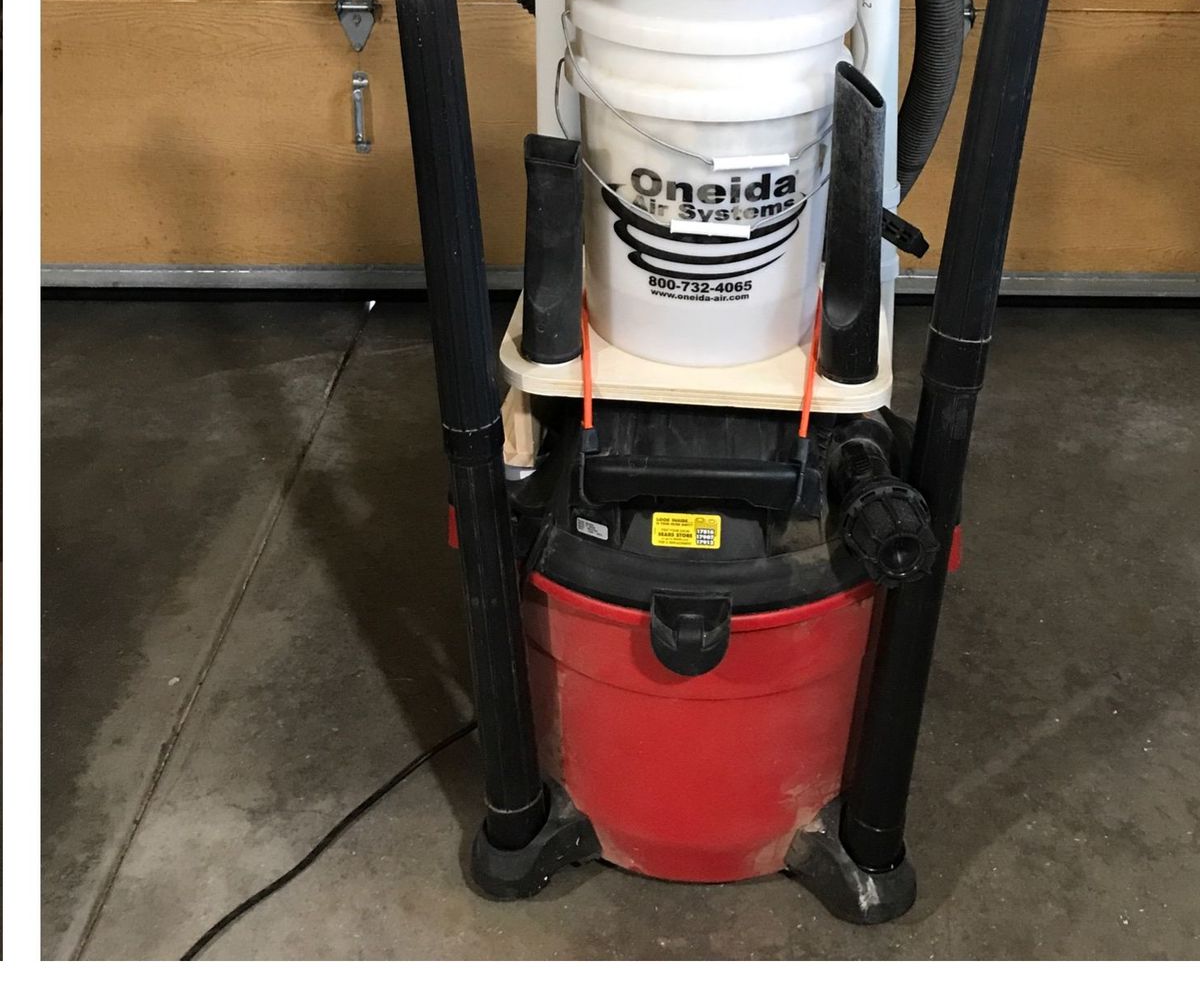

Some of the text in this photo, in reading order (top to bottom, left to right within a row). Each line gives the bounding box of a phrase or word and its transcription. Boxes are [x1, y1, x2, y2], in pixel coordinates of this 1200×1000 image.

[631, 167, 796, 204] Oneida
[632, 195, 795, 223] Air Systems
[649, 275, 753, 293] 800-732-4065
[651, 288, 749, 302] www.oneida-air.com
